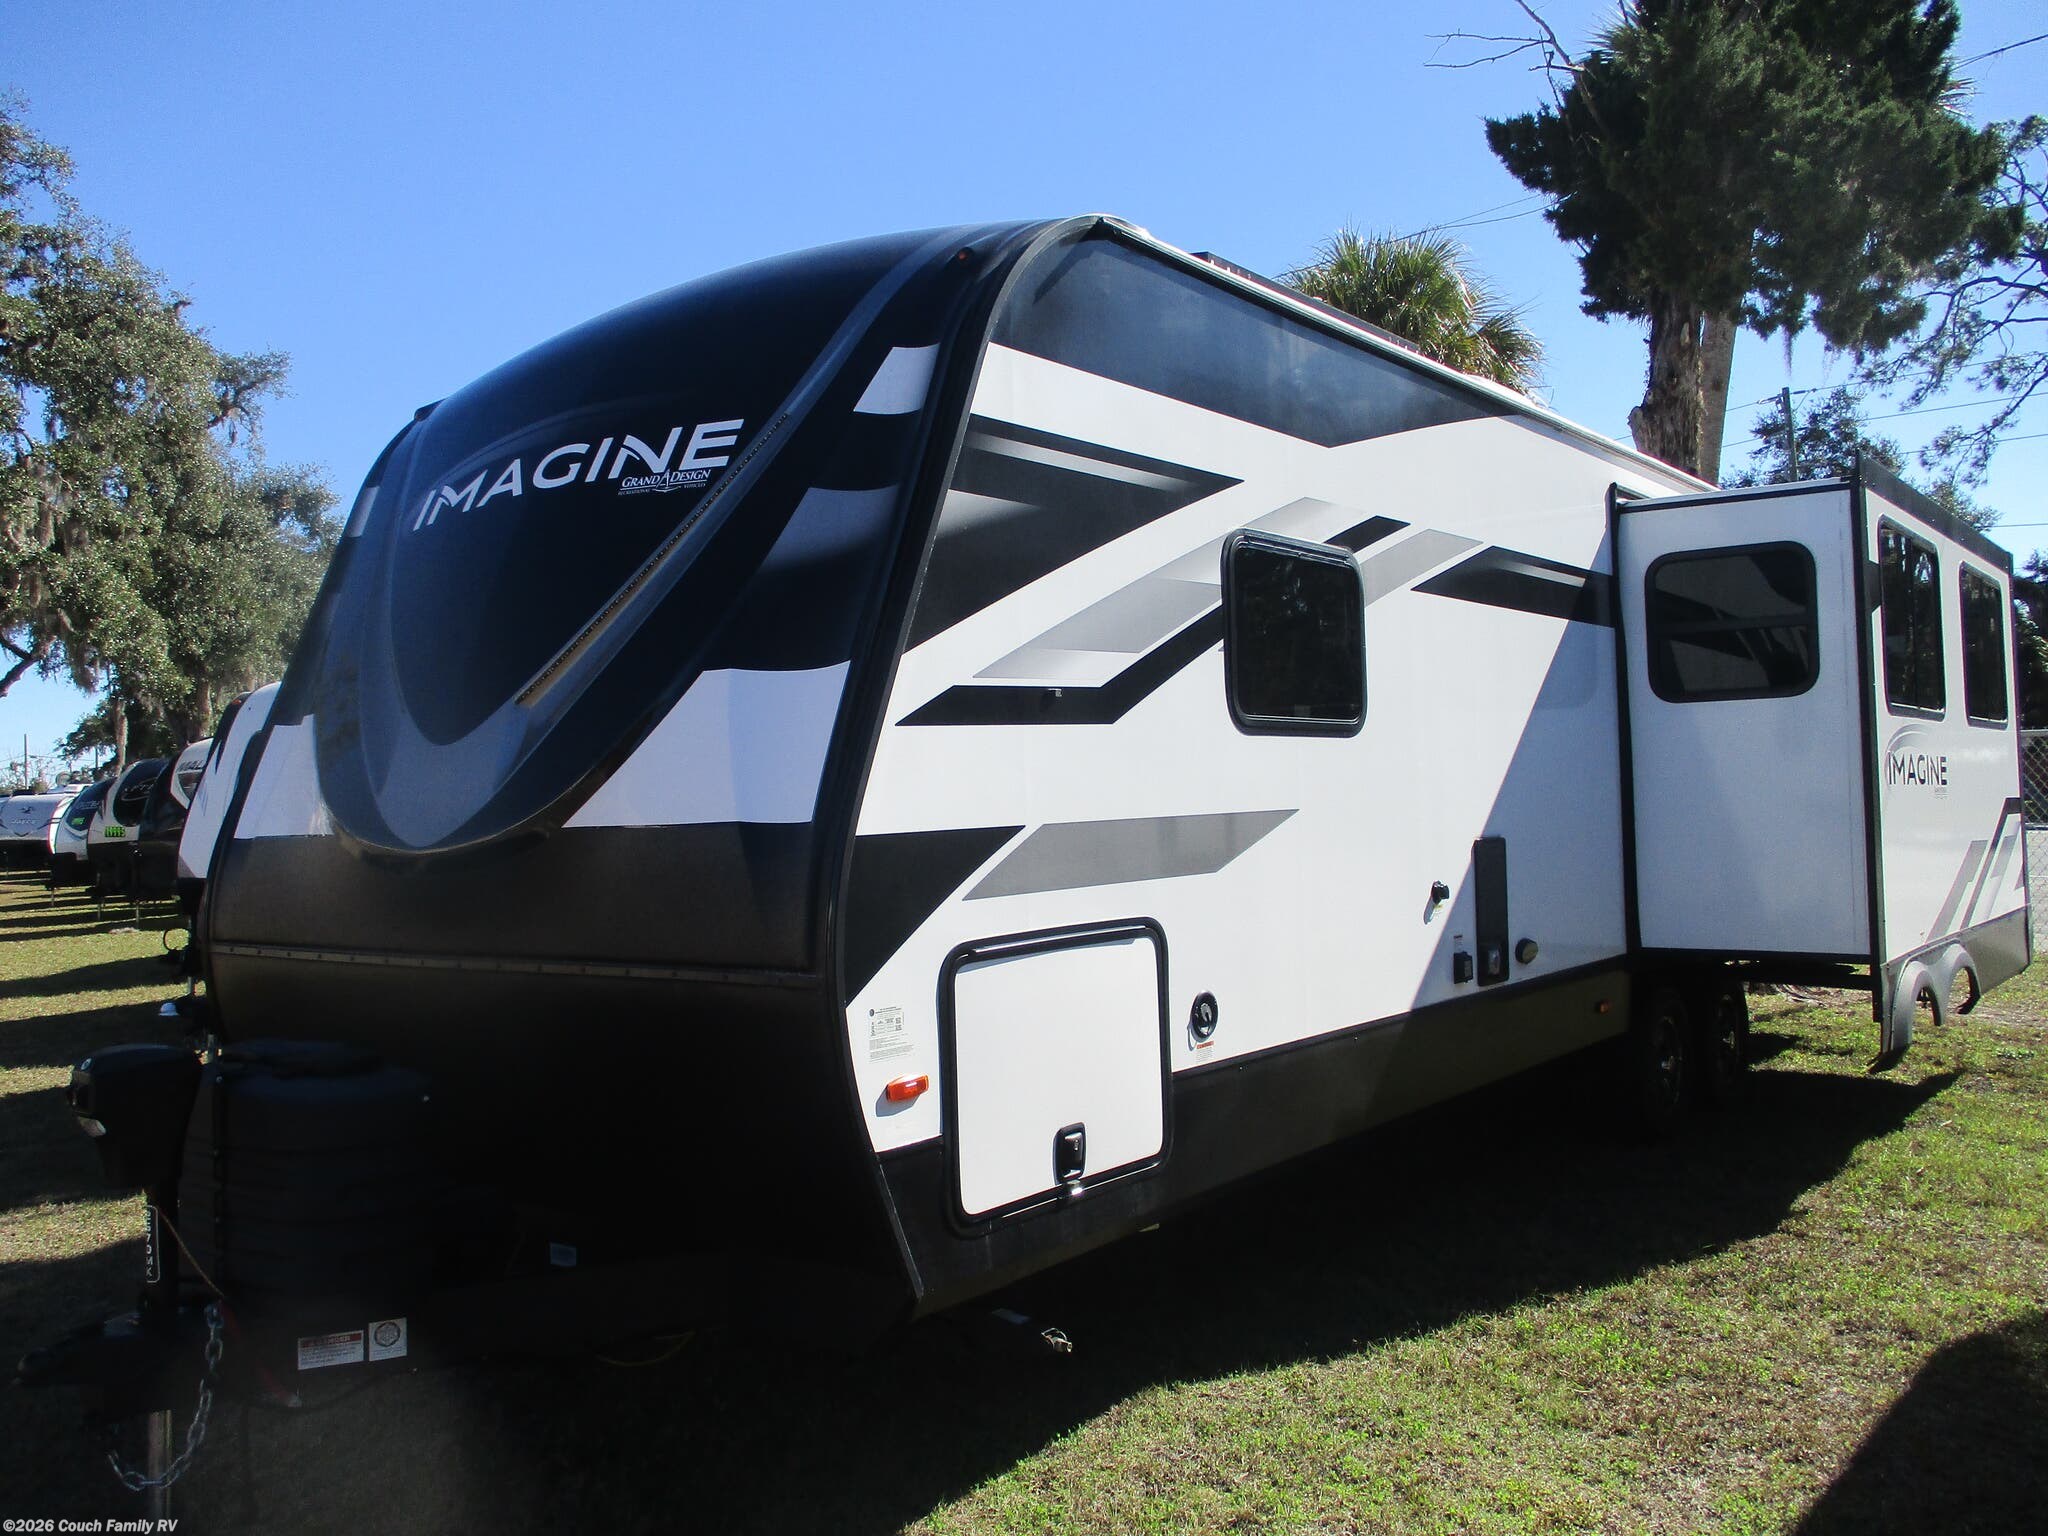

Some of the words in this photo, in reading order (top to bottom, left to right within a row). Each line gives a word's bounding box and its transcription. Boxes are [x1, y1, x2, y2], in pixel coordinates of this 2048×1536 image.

[413, 418, 745, 532] IMAGINE
[621, 475, 660, 487] GRAND
[670, 469, 711, 482] DESIGN
[1887, 752, 1948, 786] IMAGINE
